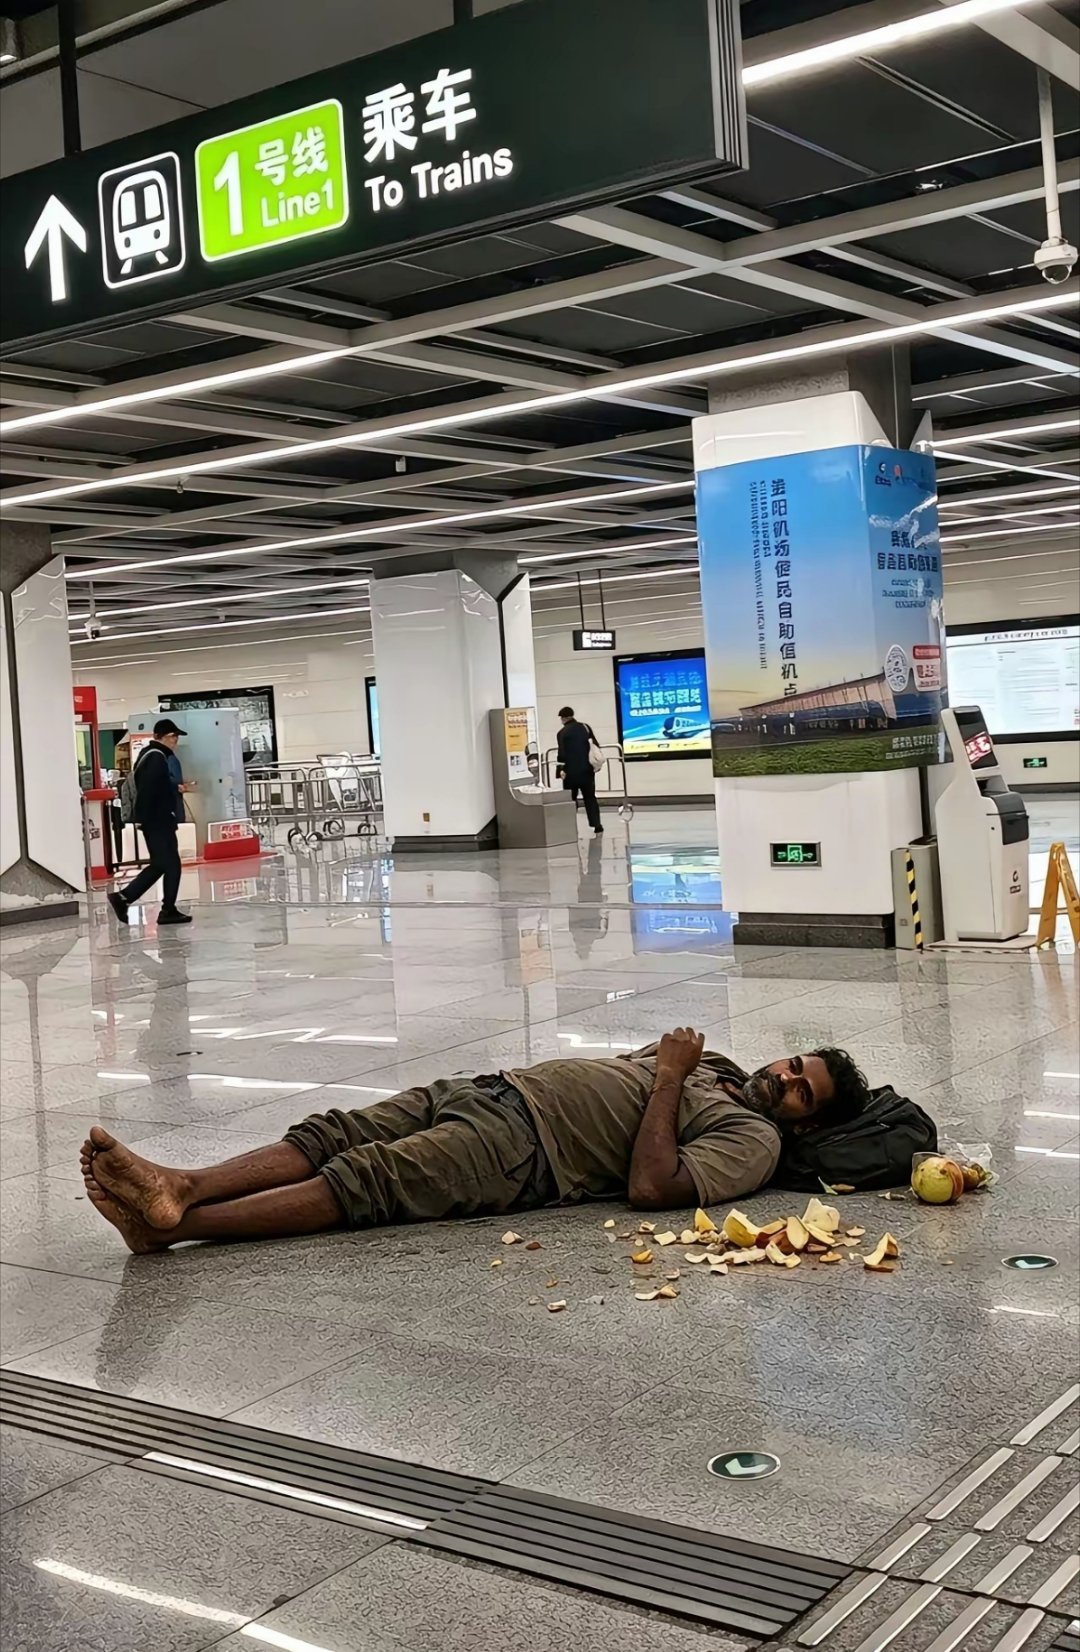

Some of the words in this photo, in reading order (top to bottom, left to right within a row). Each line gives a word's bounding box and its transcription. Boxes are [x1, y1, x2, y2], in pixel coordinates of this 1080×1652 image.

[362, 68, 477, 163] 乘车
[364, 175, 404, 212] To
[411, 148, 513, 199] Trains
